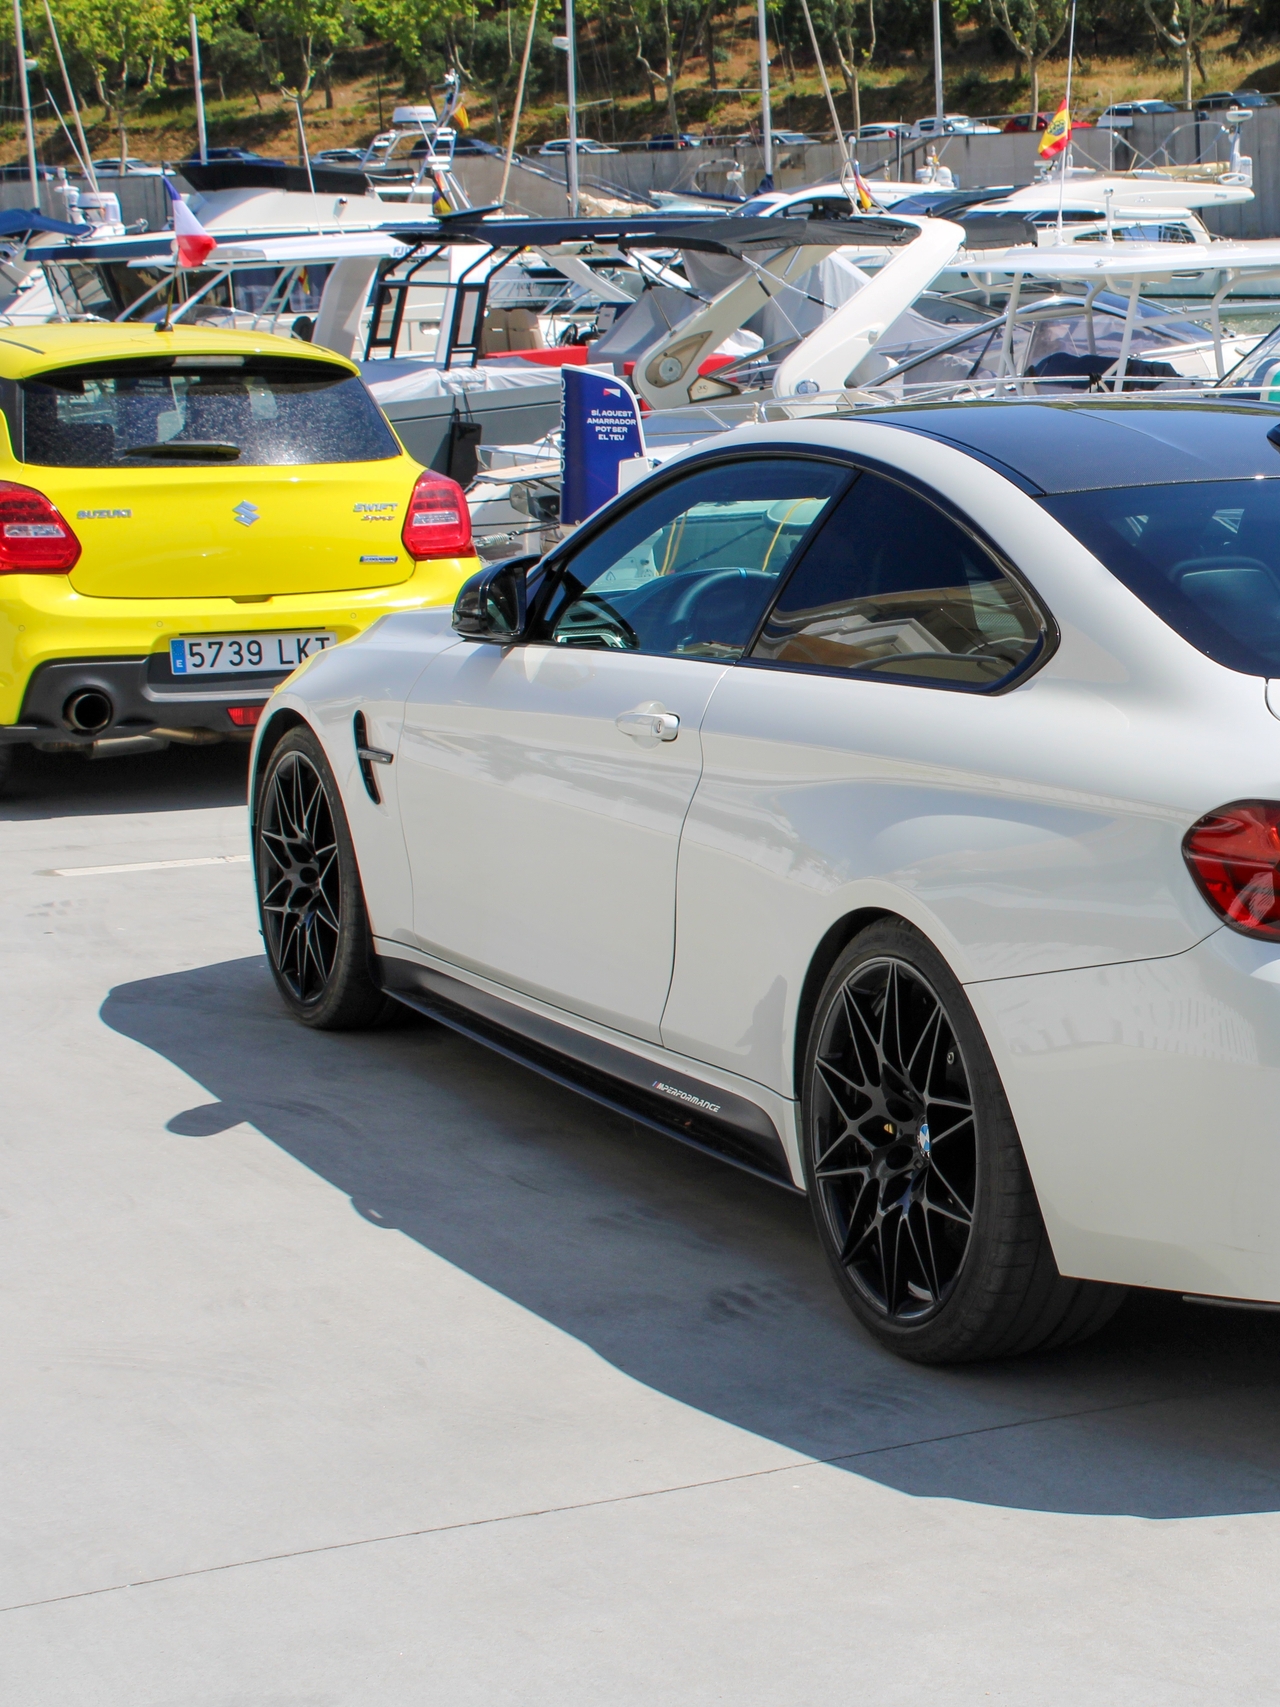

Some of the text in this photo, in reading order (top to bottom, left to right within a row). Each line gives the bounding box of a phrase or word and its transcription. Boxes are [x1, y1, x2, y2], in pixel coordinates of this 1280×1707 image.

[353, 503, 398, 512] SWIFT
[77, 509, 132, 519] SUZUKI
[176, 637, 330, 668] E 5739 LKT
